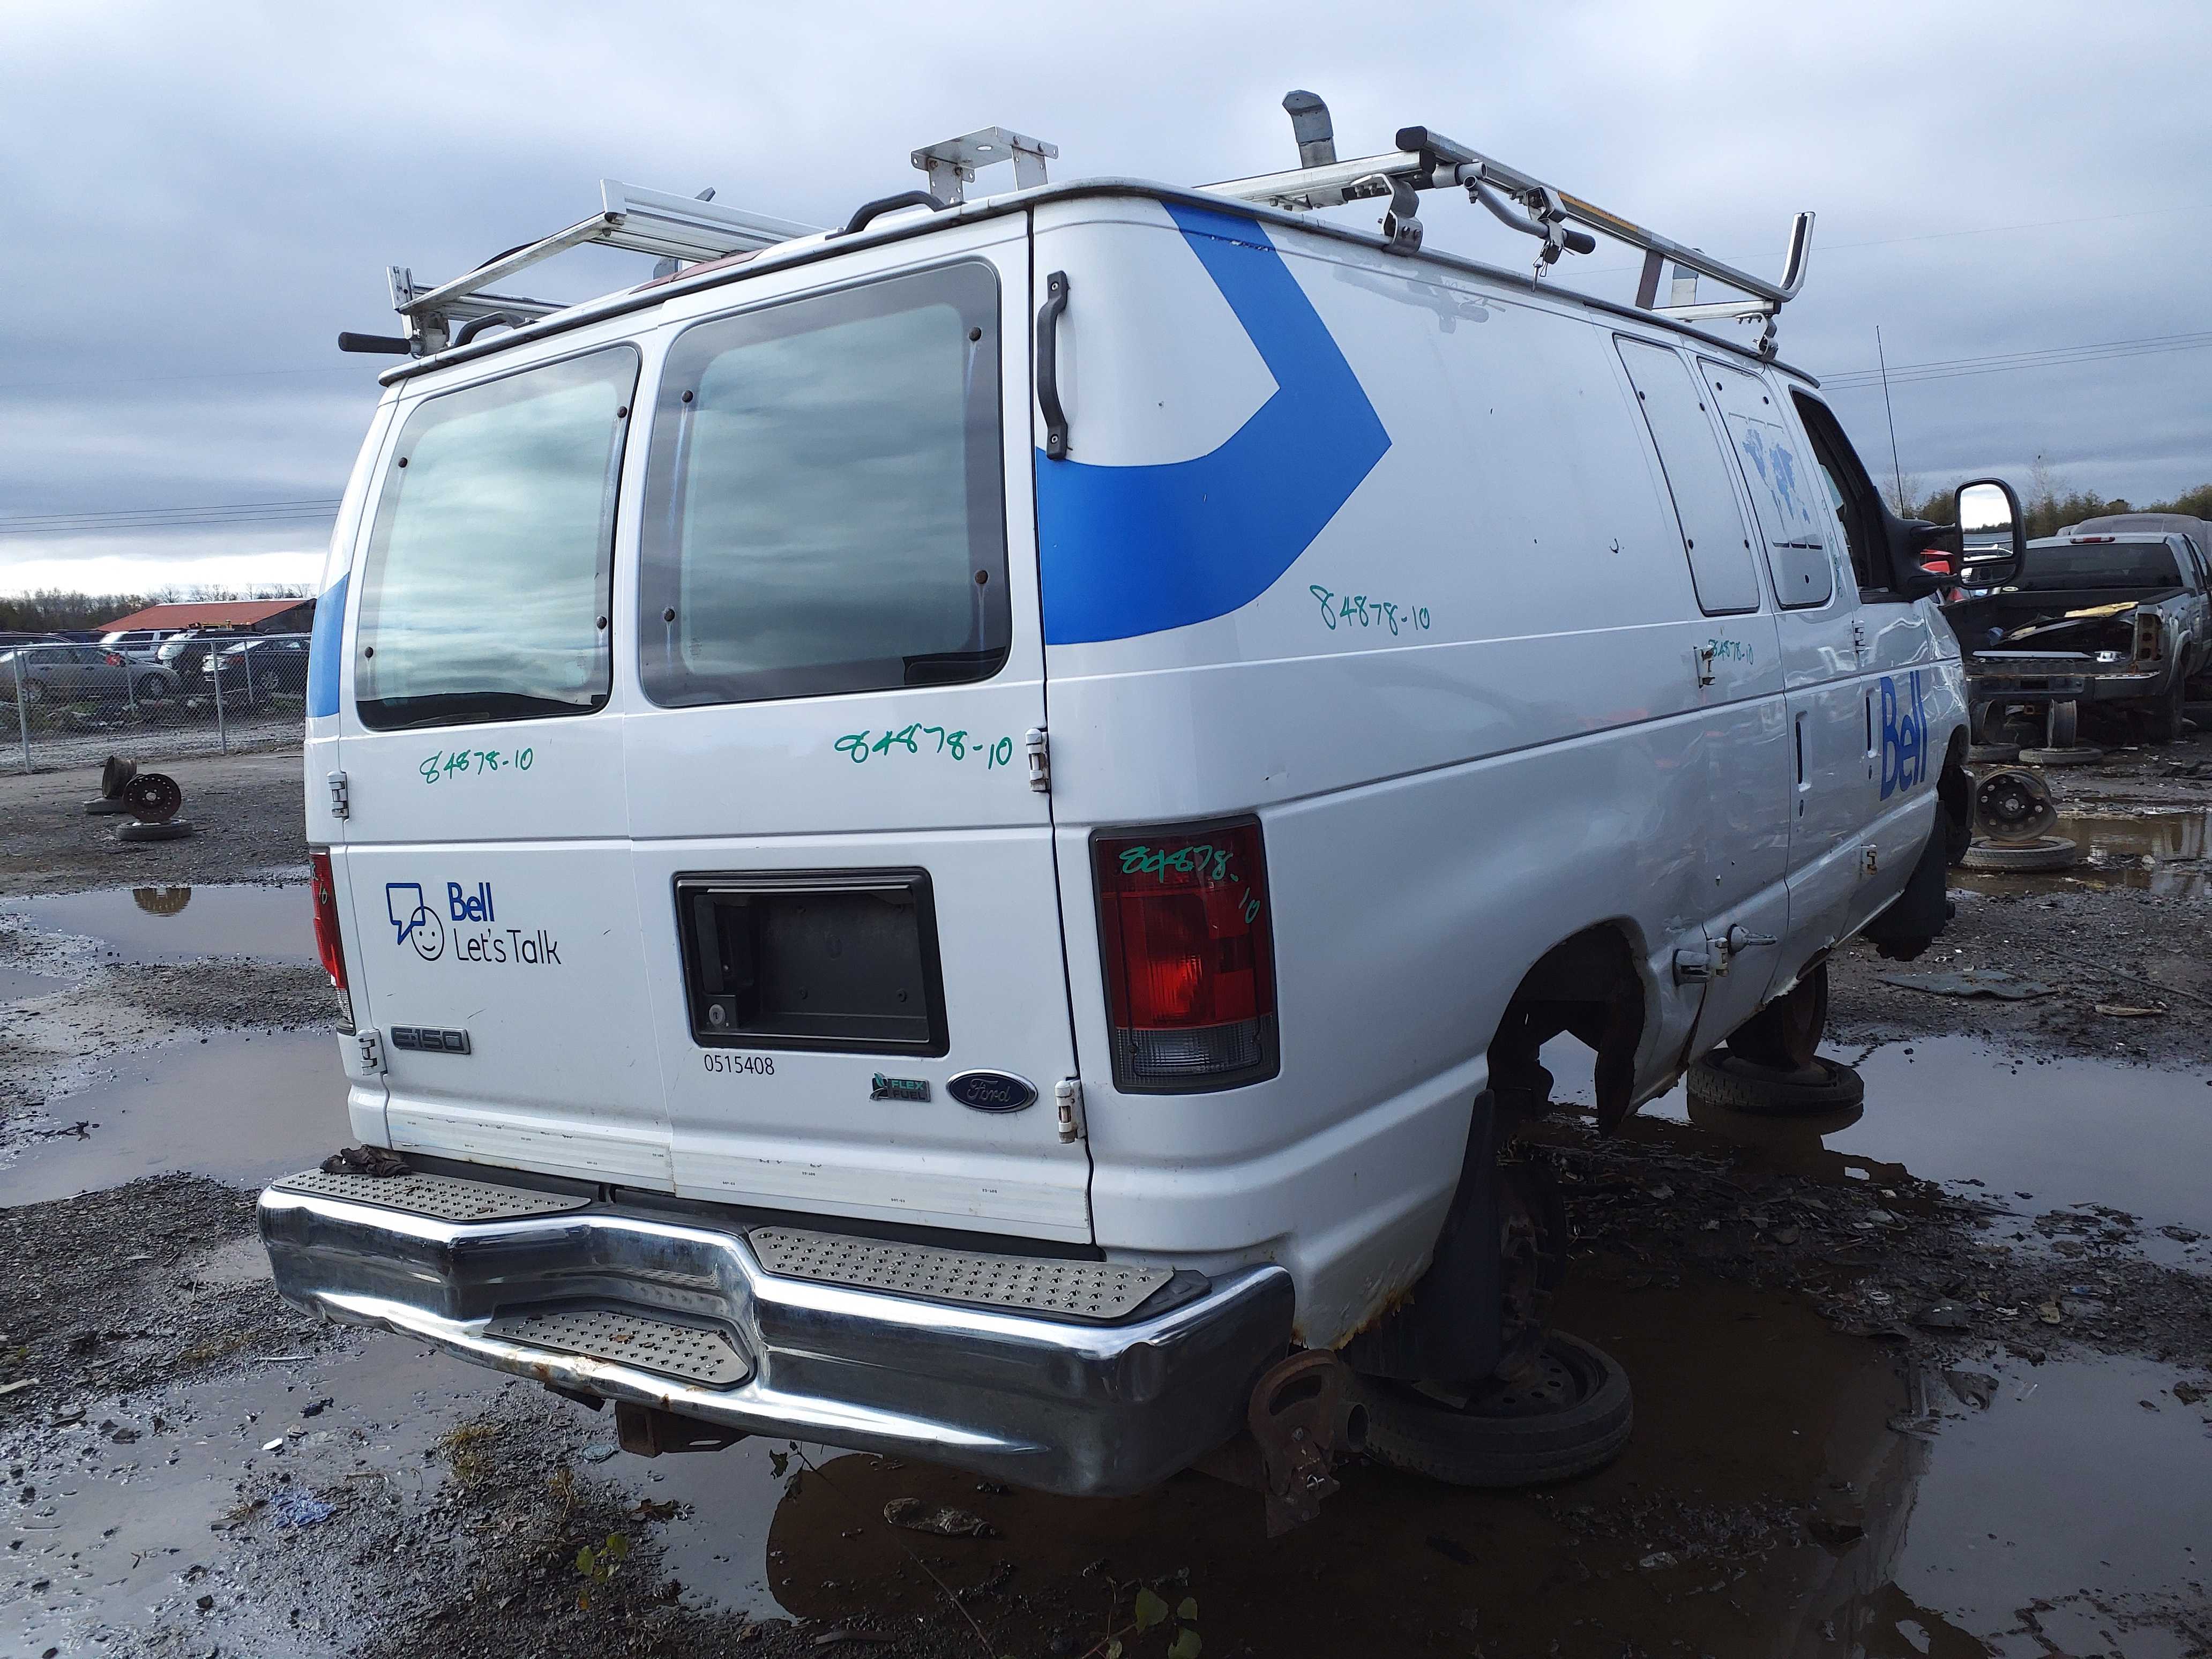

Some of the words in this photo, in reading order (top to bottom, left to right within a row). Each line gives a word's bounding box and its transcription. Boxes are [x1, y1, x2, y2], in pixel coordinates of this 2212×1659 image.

[1880, 670, 1927, 802] Bell
[419, 748, 533, 784] 84878-10
[447, 882, 495, 922] Bell
[453, 928, 506, 963] Let's
[506, 929, 562, 965] Talk
[704, 1054, 775, 1075] 0515408
[891, 1079, 924, 1090] FLEX
[893, 1089, 927, 1100] FUEL
[966, 1078, 1012, 1103] Ford
